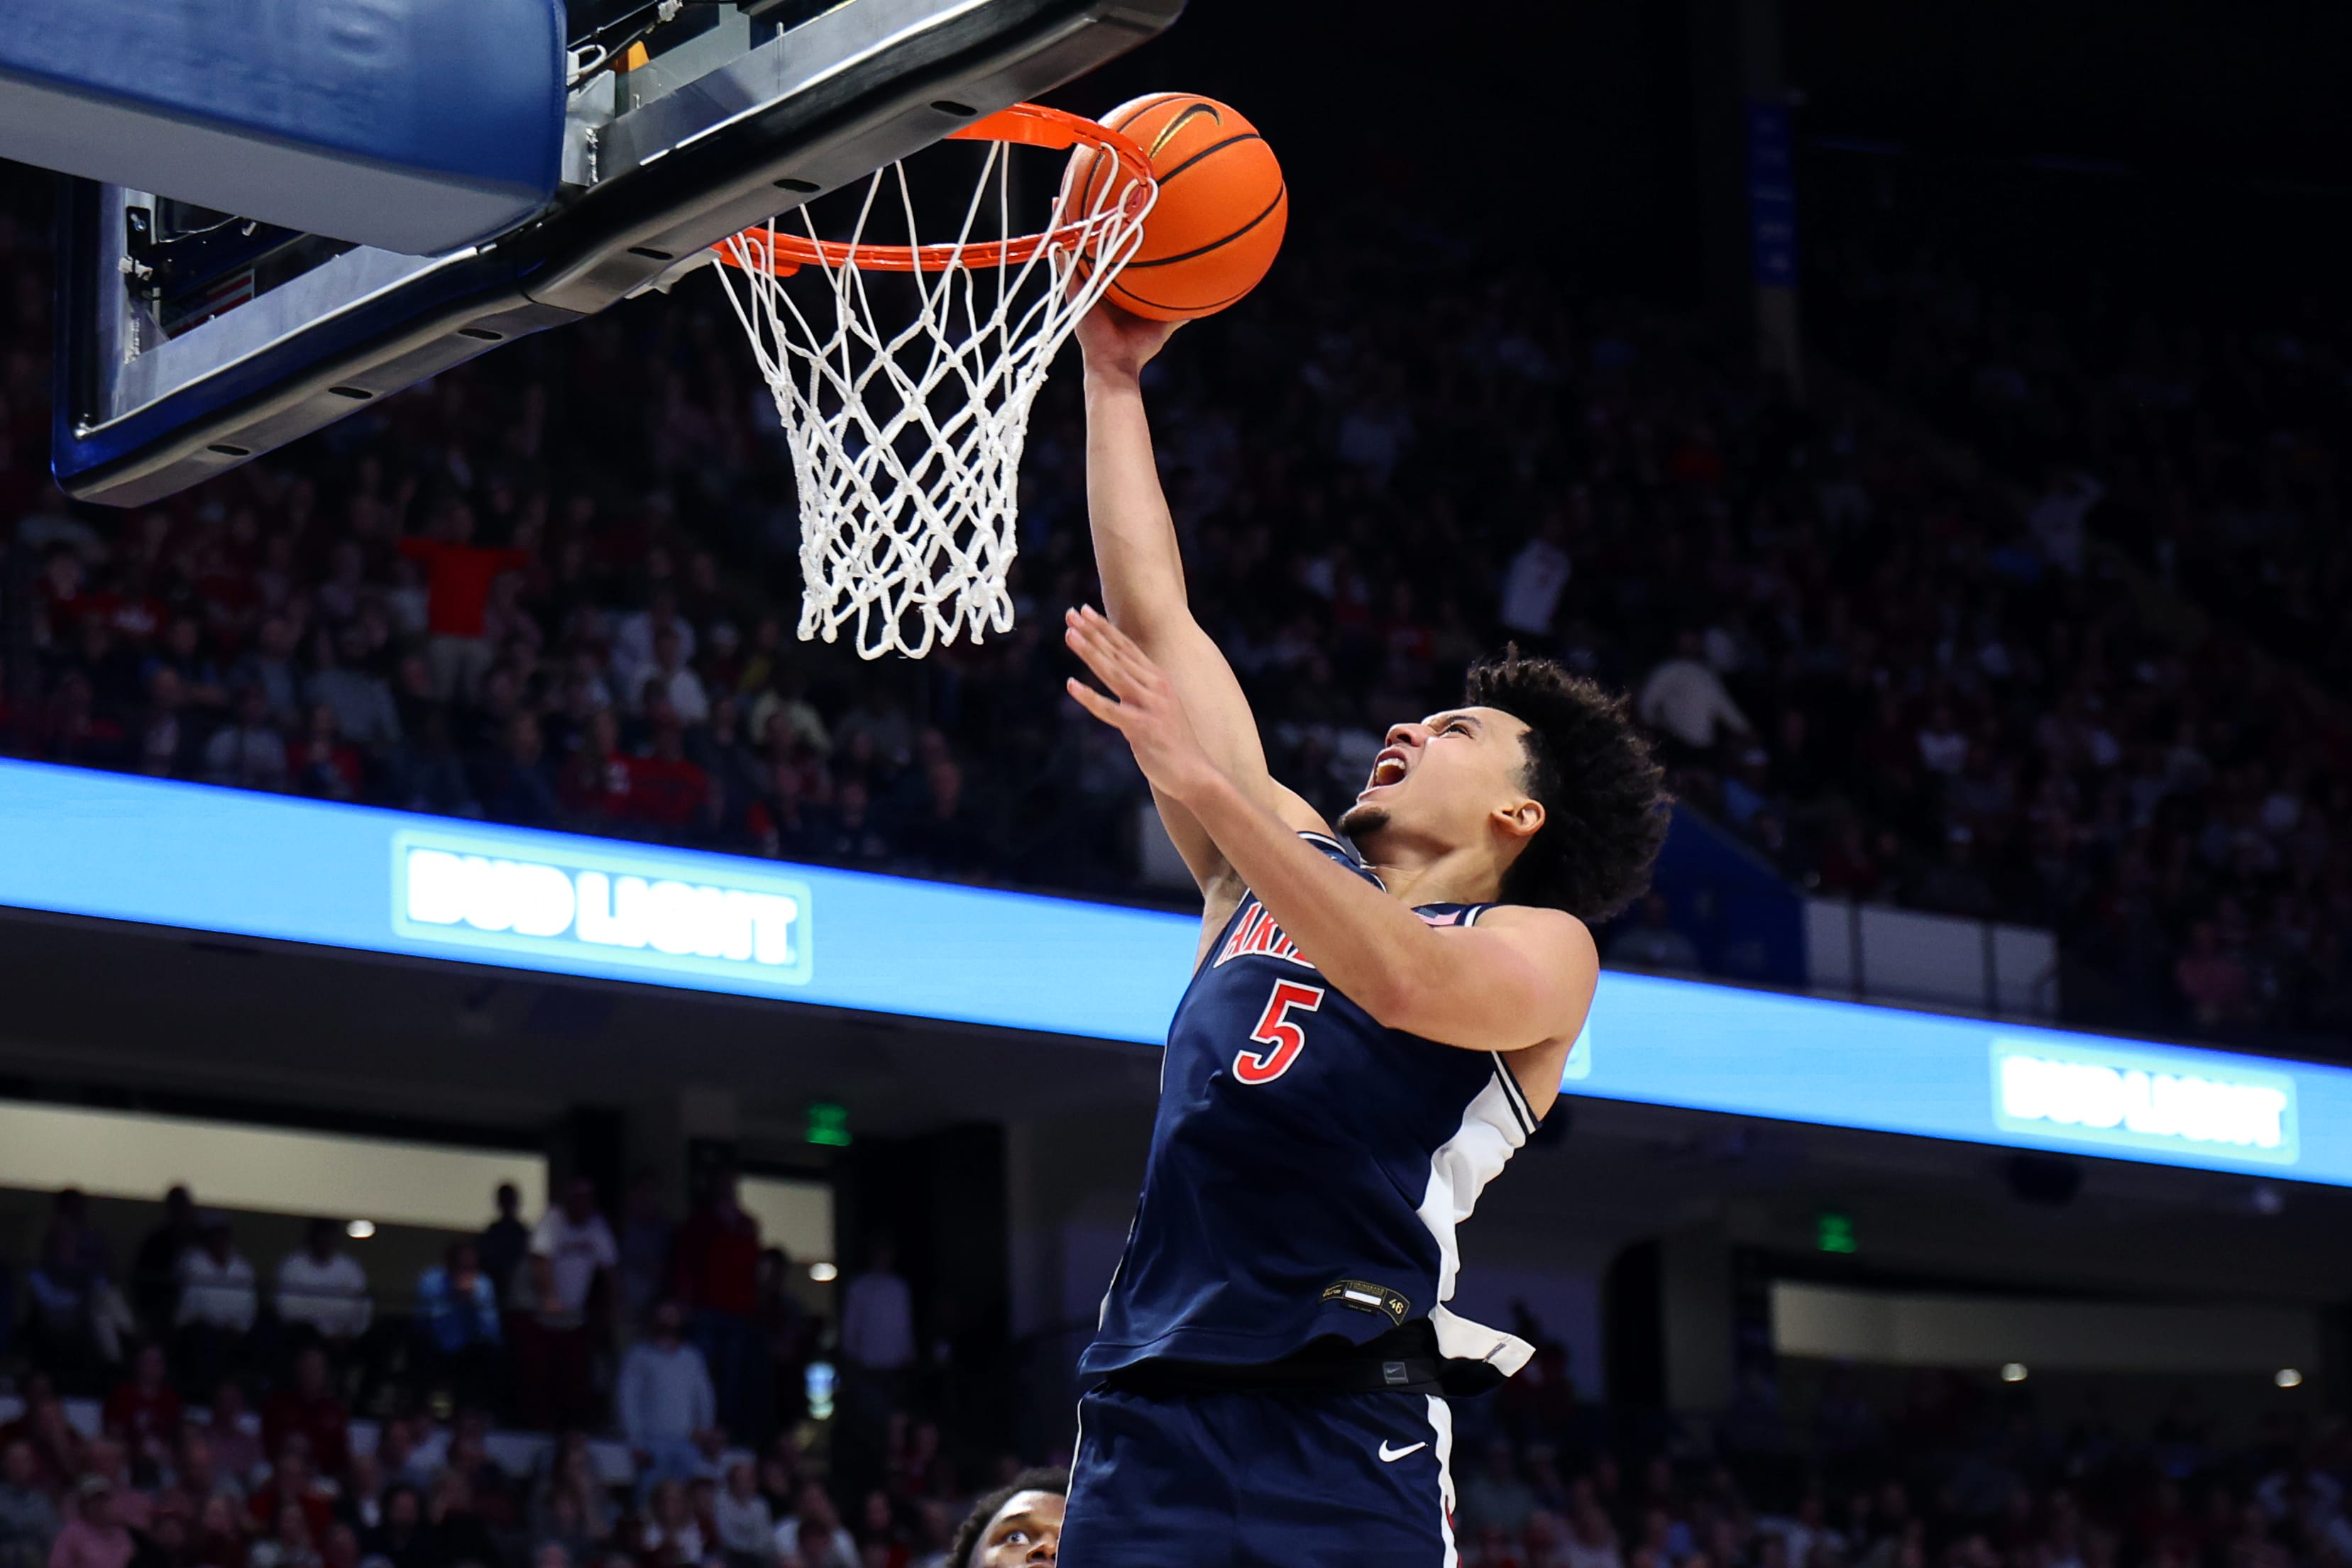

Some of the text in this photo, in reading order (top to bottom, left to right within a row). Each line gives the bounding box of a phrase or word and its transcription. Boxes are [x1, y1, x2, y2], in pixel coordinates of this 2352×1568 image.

[408, 850, 576, 937] BUD
[1232, 978, 1325, 1086] 5
[1388, 1298, 1405, 1315] 46
